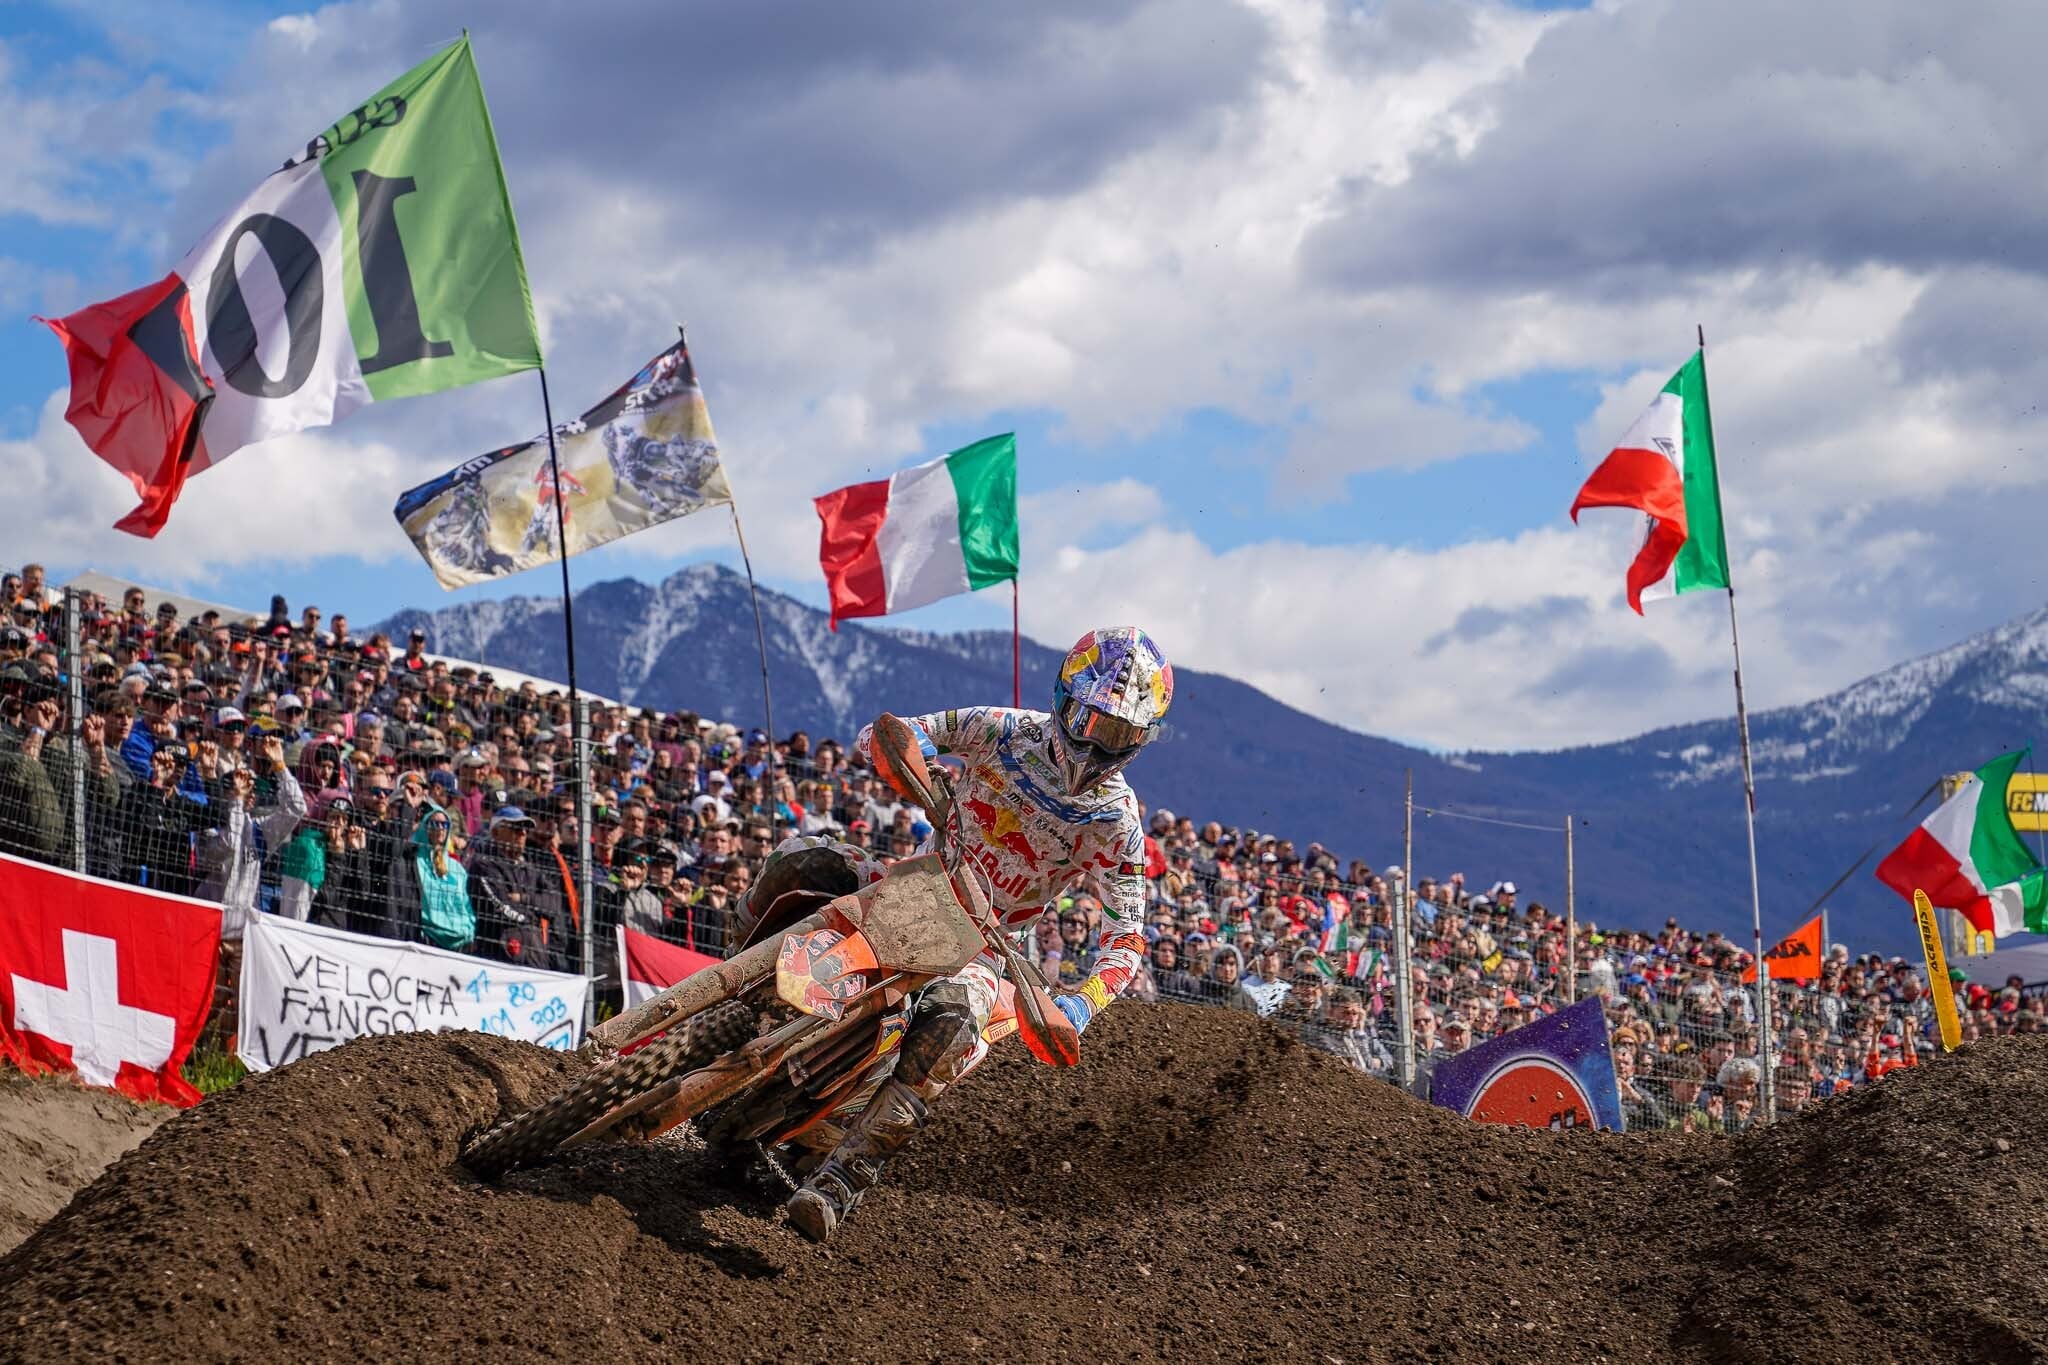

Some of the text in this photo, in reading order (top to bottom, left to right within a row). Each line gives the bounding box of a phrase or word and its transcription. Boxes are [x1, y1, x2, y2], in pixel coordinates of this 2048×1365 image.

[975, 851, 1031, 898] Bull
[1919, 911, 1939, 972] ACERBIS
[508, 982, 536, 1007] 80
[530, 996, 567, 1026] 303
